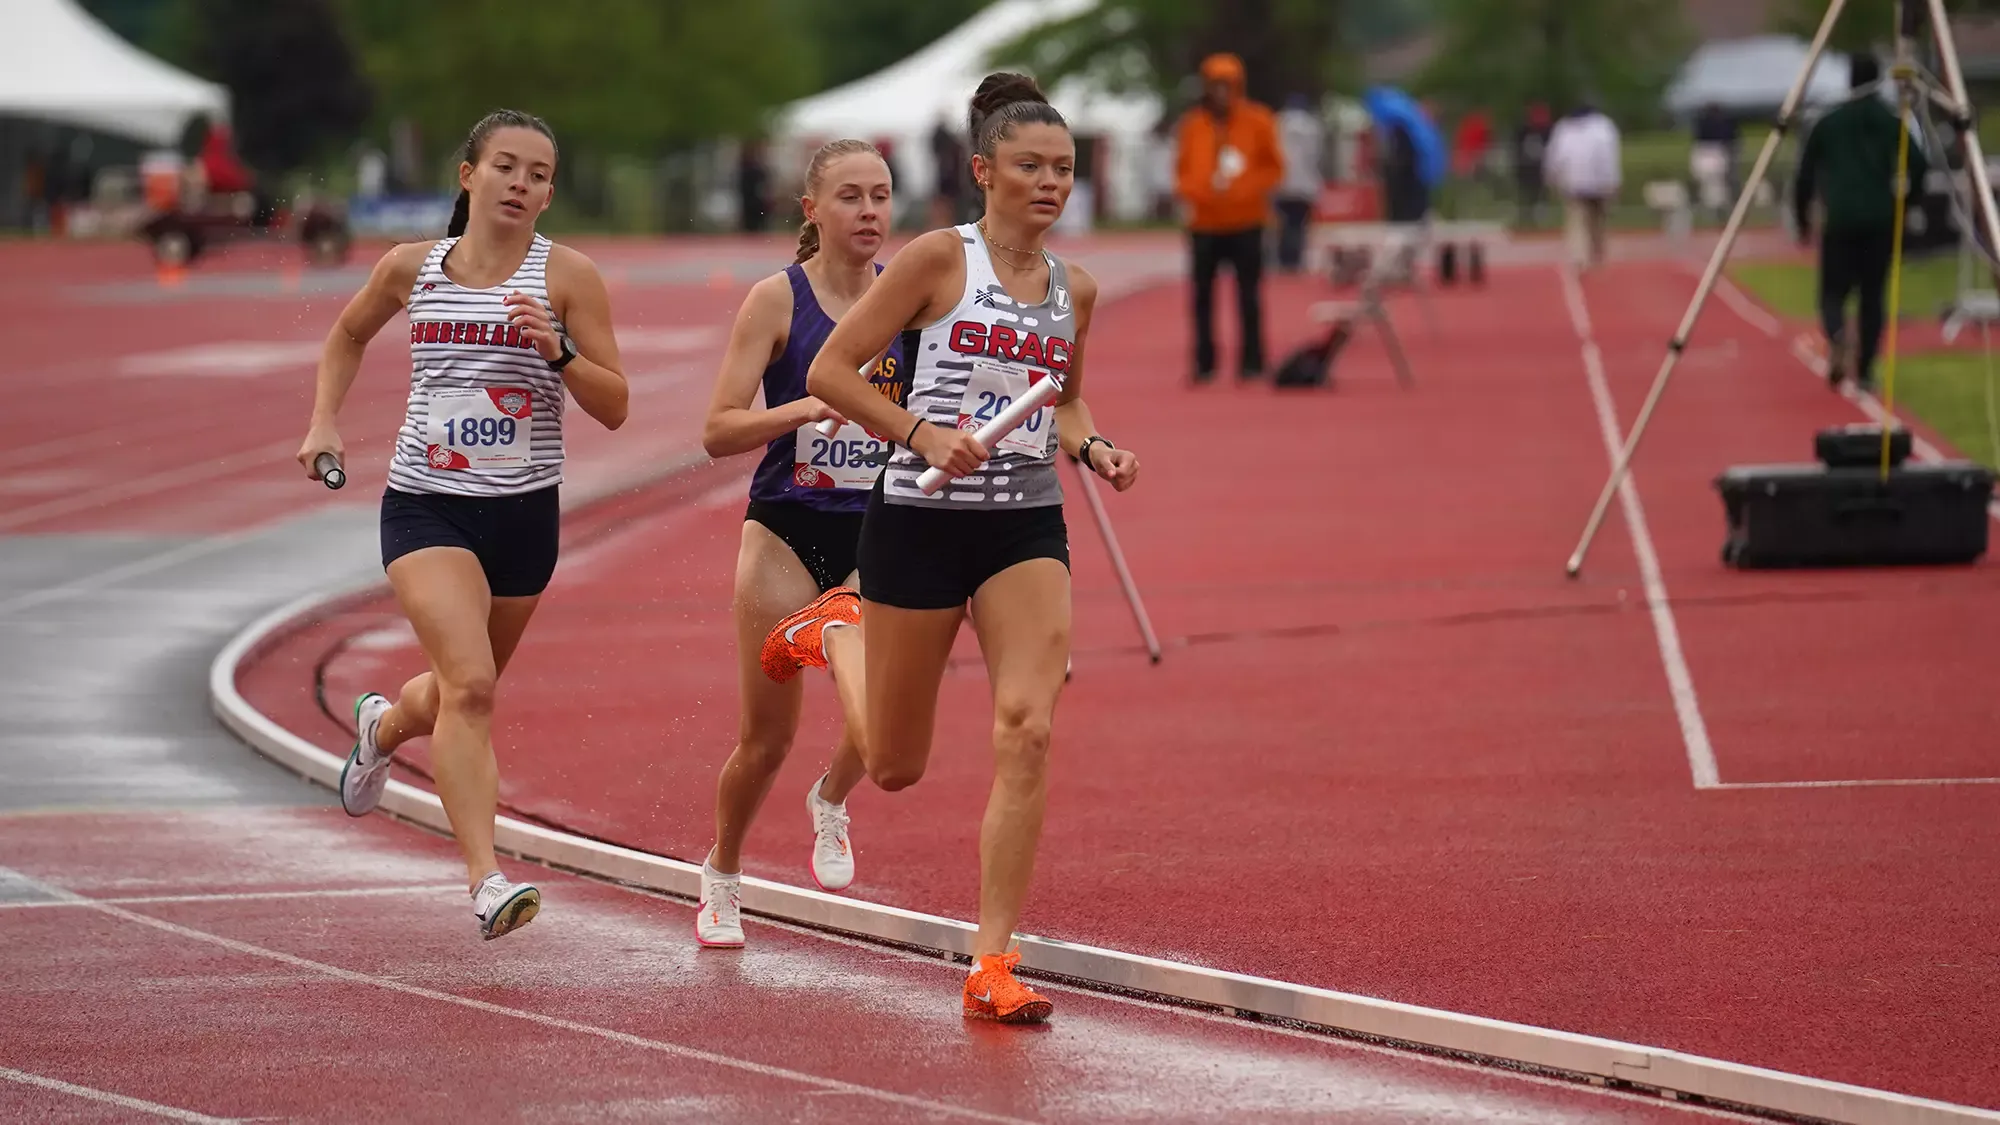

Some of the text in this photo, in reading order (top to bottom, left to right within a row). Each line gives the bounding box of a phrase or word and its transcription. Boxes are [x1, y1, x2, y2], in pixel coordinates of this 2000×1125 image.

[975, 391, 1043, 432] 200
[444, 417, 516, 446] 1899
[811, 438, 880, 468] 2053
